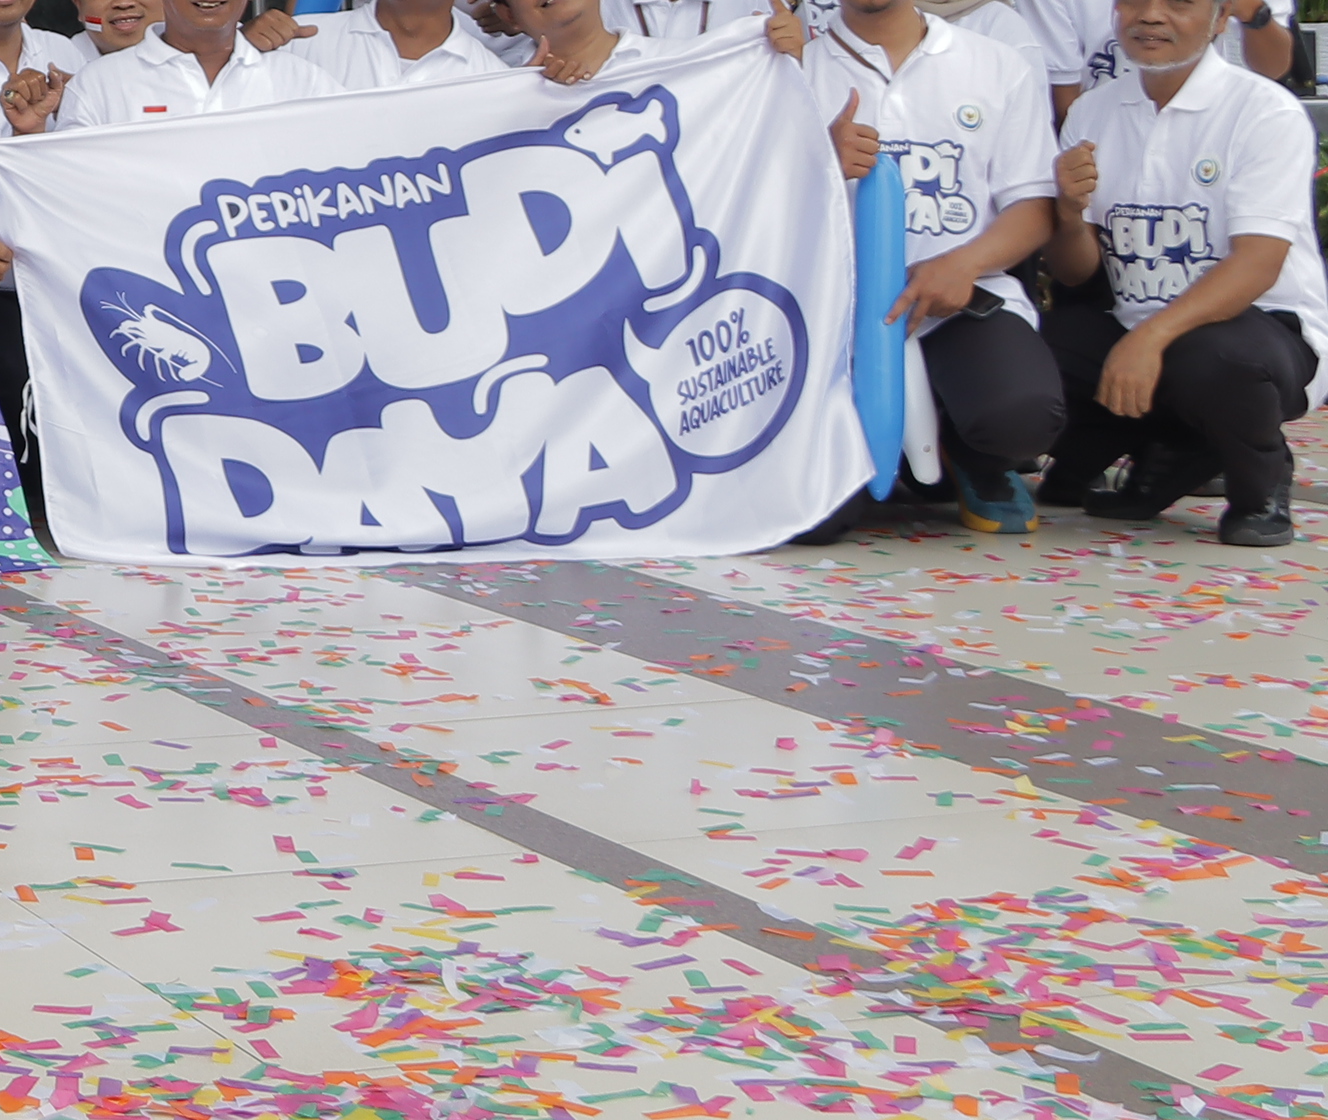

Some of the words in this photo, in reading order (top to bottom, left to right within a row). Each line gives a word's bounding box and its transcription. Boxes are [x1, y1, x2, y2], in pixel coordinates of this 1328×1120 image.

[1107, 256, 1189, 301] DAYA
[677, 337, 776, 405] SUSTAINABLE
[685, 307, 750, 367] 100%
[679, 360, 785, 436] AQUACULTURE
[162, 365, 679, 555] DAYA
